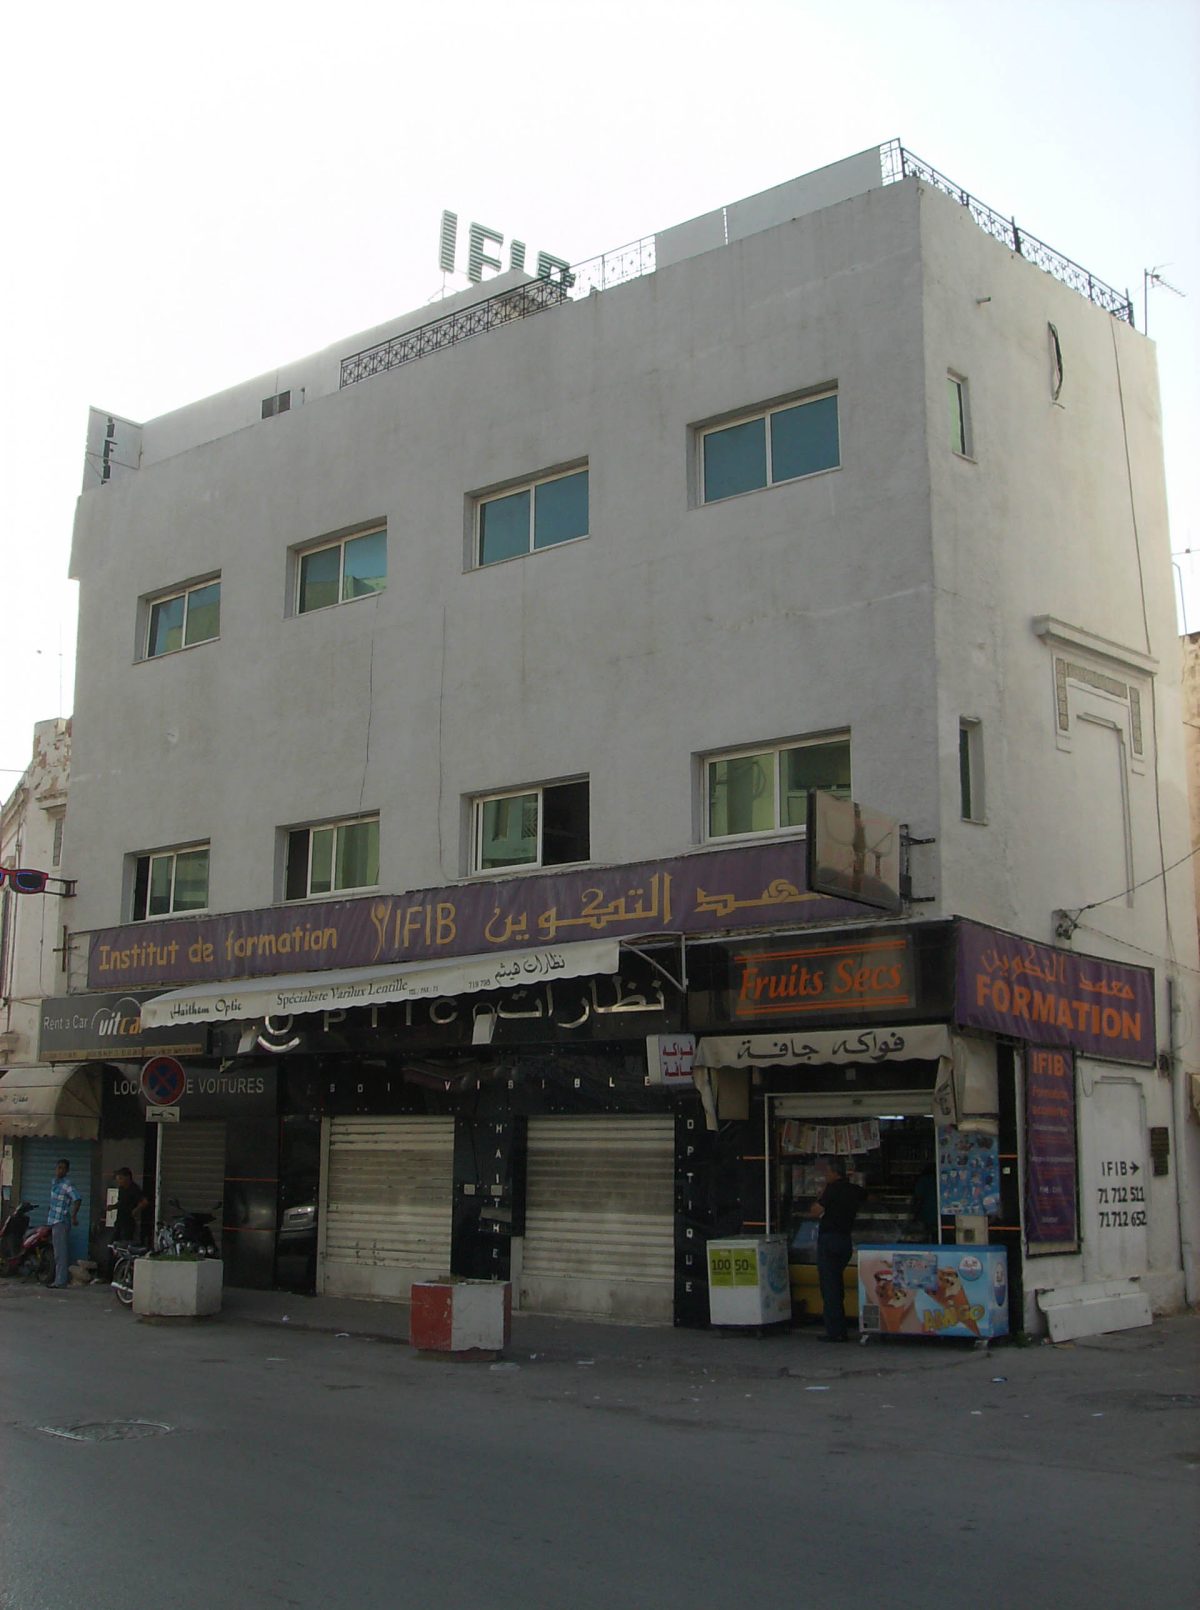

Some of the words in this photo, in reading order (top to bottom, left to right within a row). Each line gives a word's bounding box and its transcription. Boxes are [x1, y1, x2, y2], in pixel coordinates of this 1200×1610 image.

[484, 872, 672, 944] التكوين
[99, 940, 179, 971] Institut
[188, 935, 214, 963] de
[225, 923, 338, 961] formation
[394, 902, 457, 949] IFIB
[493, 961, 521, 985] هيثم
[523, 951, 566, 976] نظارات
[980, 943, 1067, 984] التكوين
[738, 963, 824, 1002] Fruits
[833, 958, 904, 994] Secs
[276, 991, 329, 1010] Spécialiste
[330, 985, 365, 1001] Varilux
[368, 978, 408, 996] Lentille
[497, 975, 665, 1029] نظارات
[169, 1001, 210, 1019] Haithem
[215, 997, 243, 1017] Optic
[975, 973, 1142, 1042] FORMATION
[43, 1016, 63, 1030] Rent
[65, 1019, 71, 1029] a
[72, 1014, 88, 1030] Car
[97, 1011, 143, 1036] vitca
[737, 1039, 819, 1061] جافة
[832, 1031, 905, 1060] فواكه
[1032, 1051, 1065, 1078] IFIB
[198, 1077, 264, 1094] VOITURES
[1101, 1161, 1127, 1177] IFIB
[1098, 1188, 1109, 1204] 71
[1111, 1187, 1128, 1204] 712
[1130, 1186, 1145, 1202] 511
[1099, 1212, 1111, 1228] 71
[1111, 1211, 1129, 1228] 712
[1131, 1210, 1147, 1227] 652
[712, 1259, 731, 1271] 100
